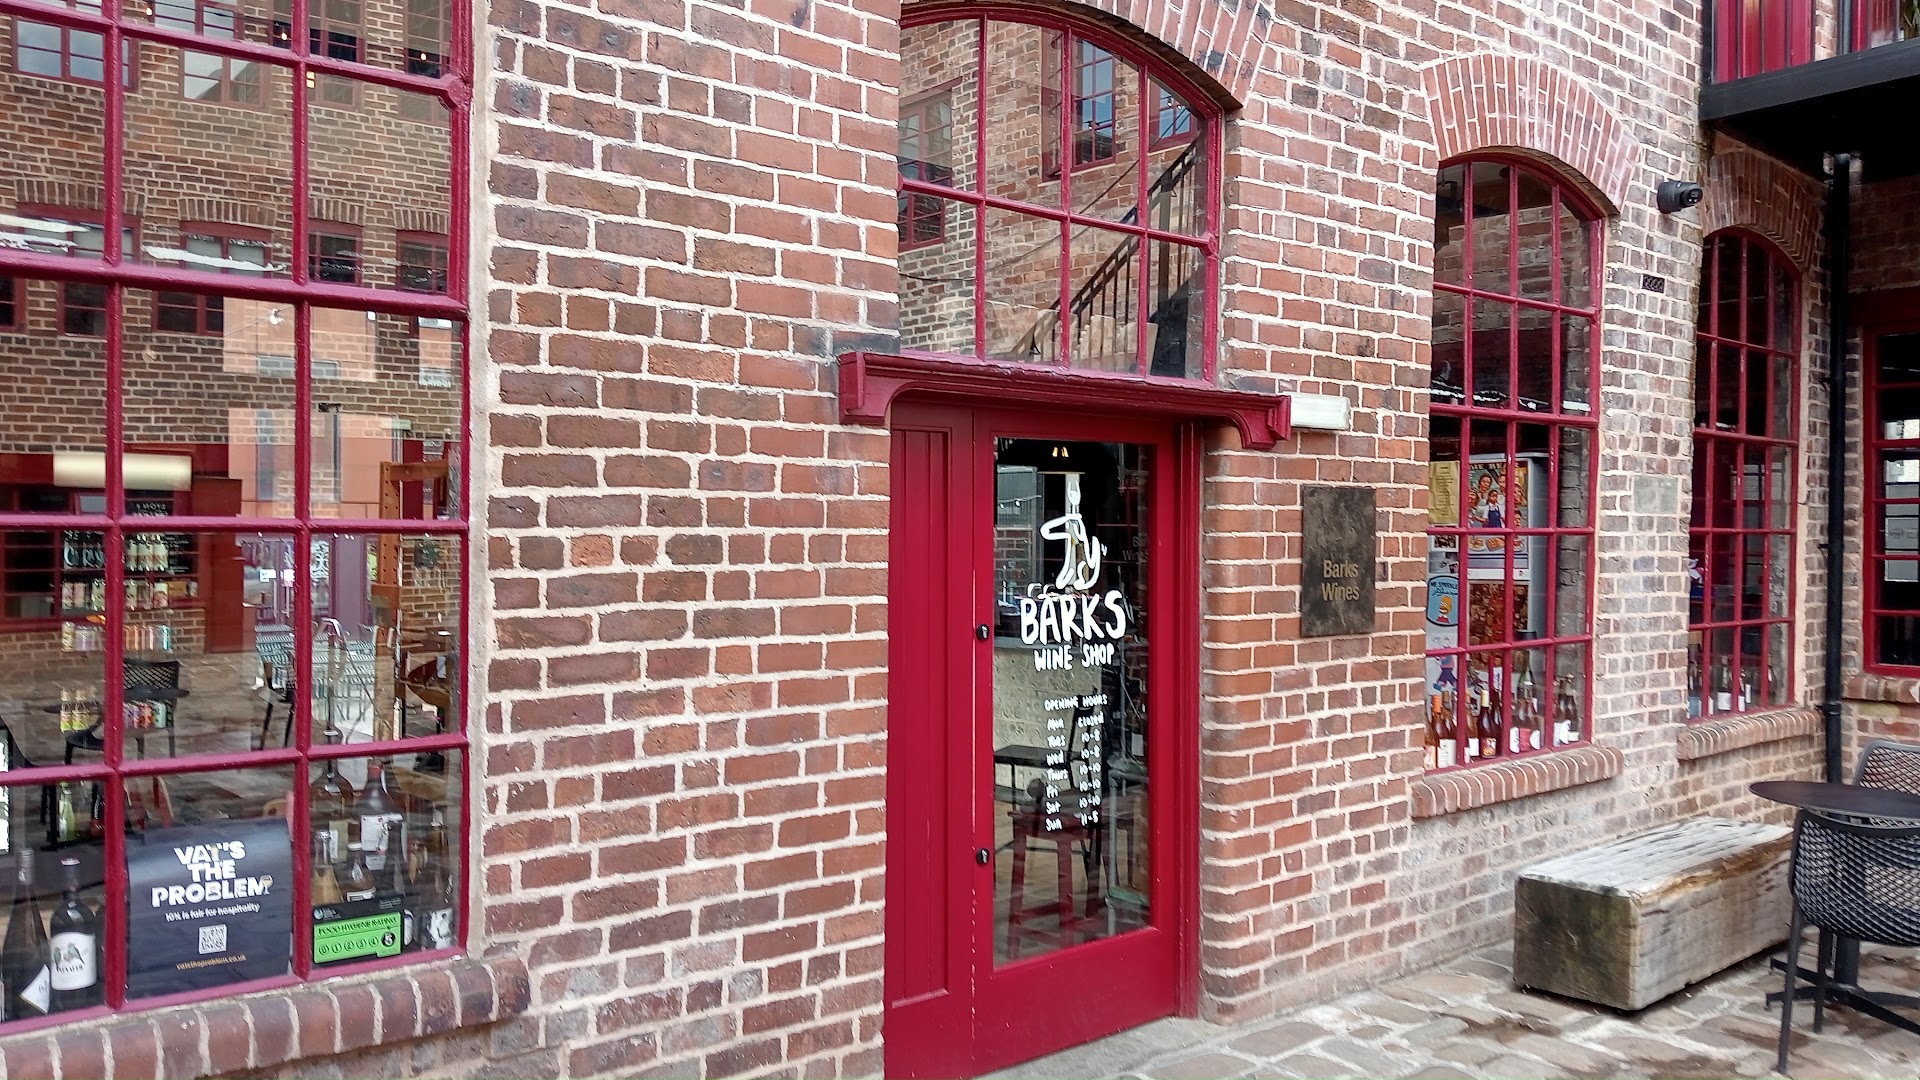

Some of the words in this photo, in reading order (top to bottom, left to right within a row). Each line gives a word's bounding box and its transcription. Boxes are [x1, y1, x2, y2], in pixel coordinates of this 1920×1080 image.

[1323, 559, 1359, 579] Barks
[1321, 582, 1360, 602] Wines
[1019, 589, 1127, 646] BARKS
[1033, 644, 1074, 672] WINE
[1081, 641, 1115, 668] SHOP
[1044, 695, 1079, 711] OPENING
[1082, 693, 1108, 708] HOURS
[173, 840, 247, 865] VAT'S
[186, 859, 237, 882] THE
[151, 875, 274, 908] PROBLEM
